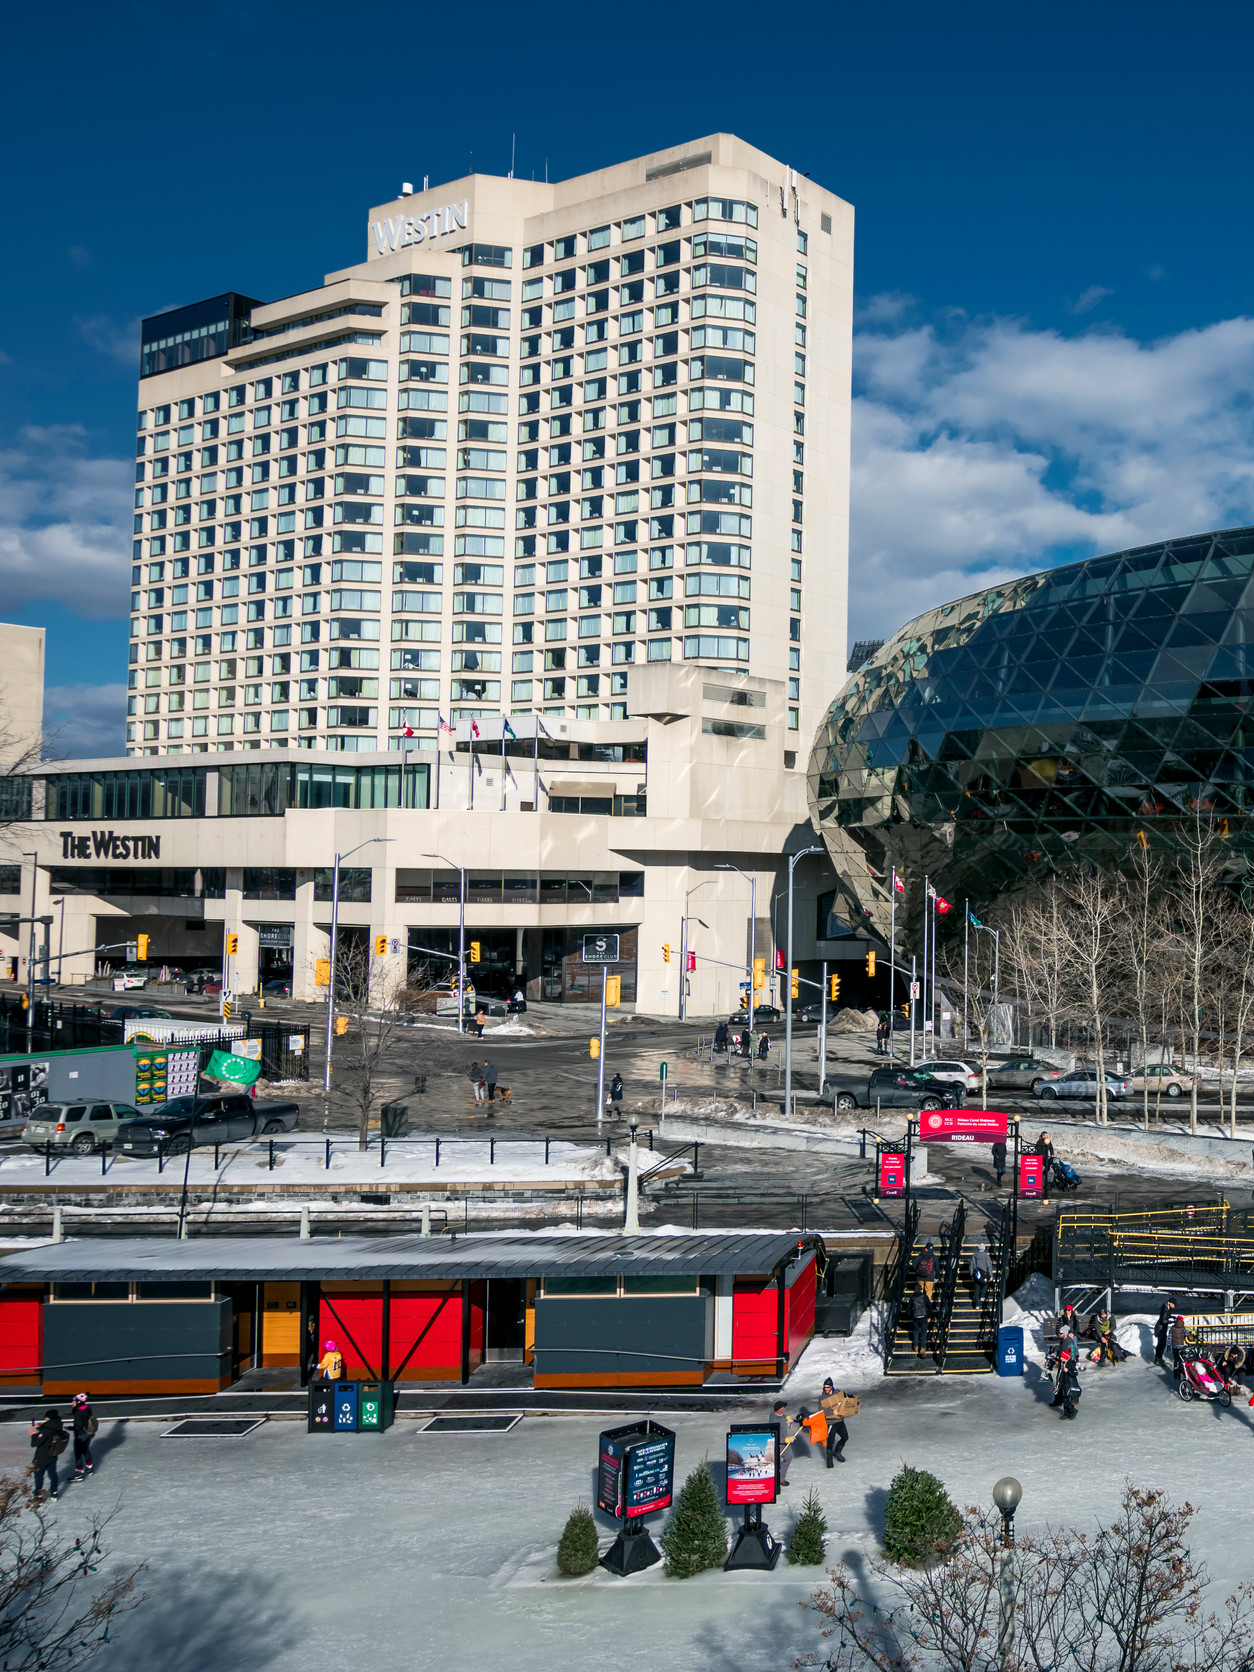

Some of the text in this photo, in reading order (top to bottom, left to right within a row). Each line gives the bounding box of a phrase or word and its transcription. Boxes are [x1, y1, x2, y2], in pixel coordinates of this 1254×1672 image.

[372, 199, 468, 255] WESTIN
[59, 830, 161, 860] THE WESTIN
